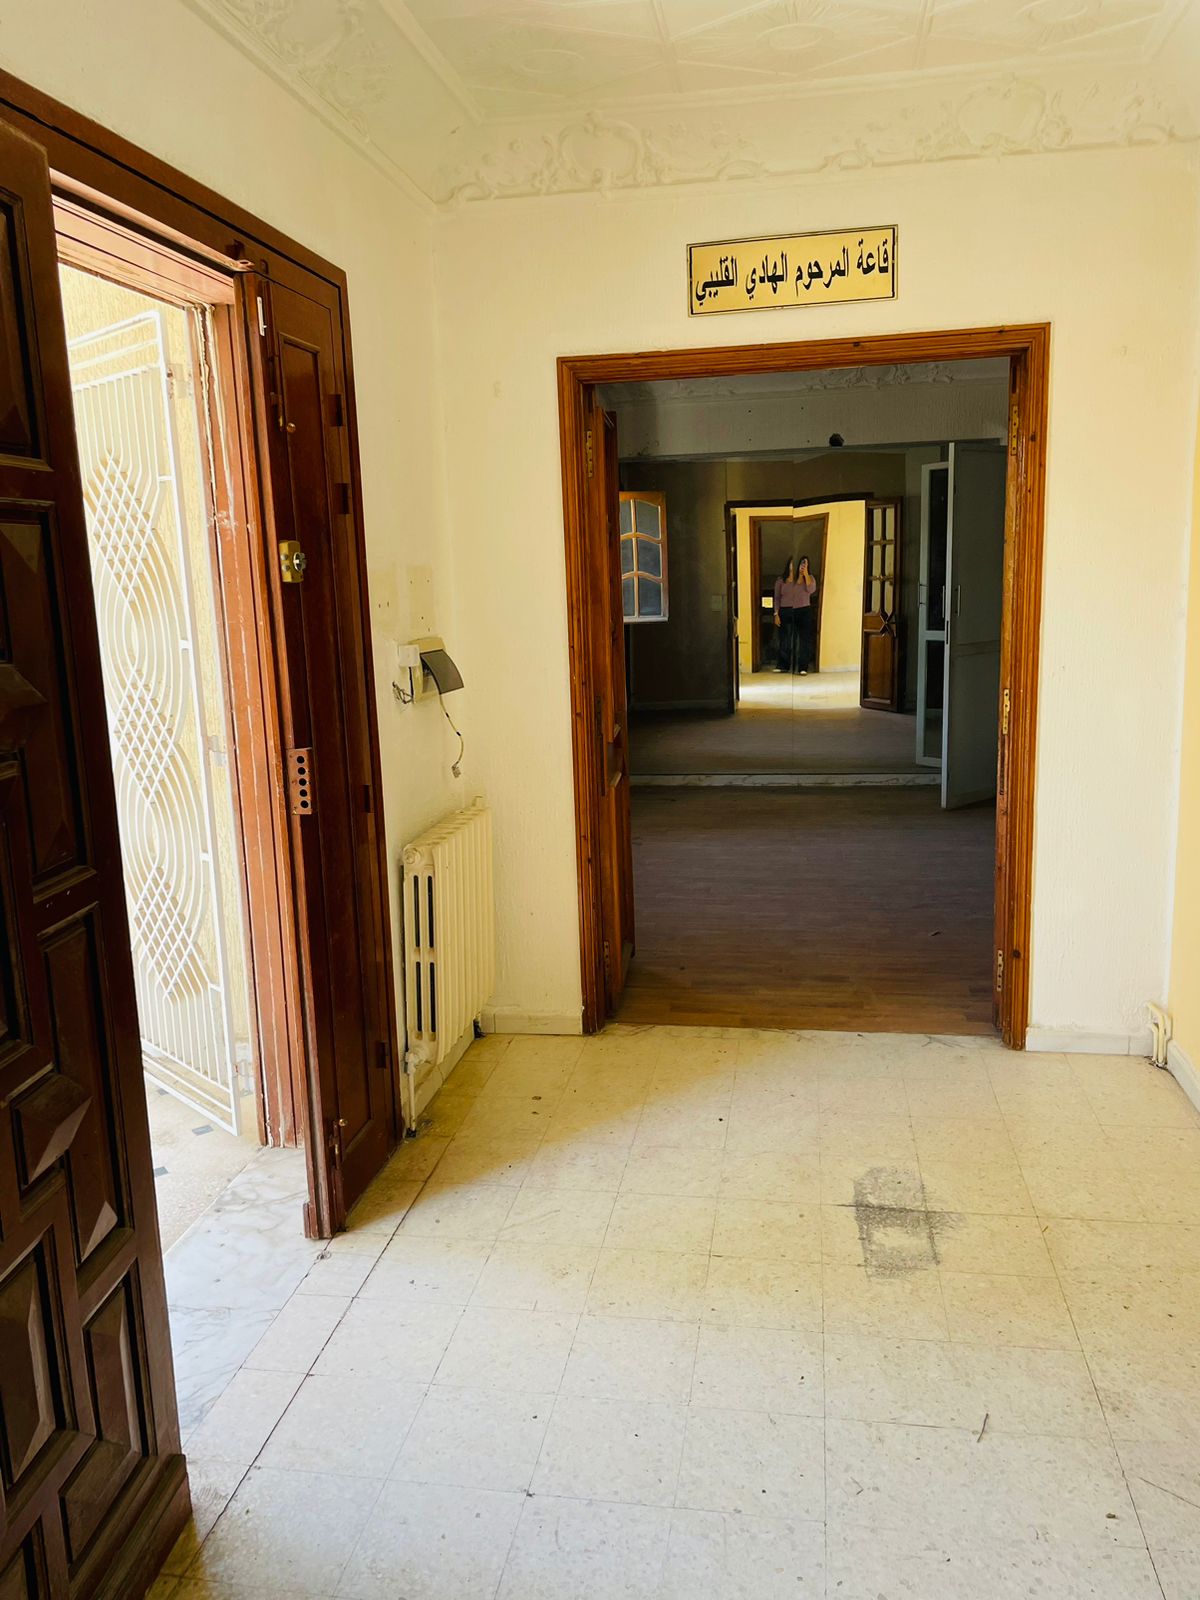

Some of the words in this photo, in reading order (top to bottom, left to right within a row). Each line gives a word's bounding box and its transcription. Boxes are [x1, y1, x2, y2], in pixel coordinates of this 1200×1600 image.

[695, 255, 738, 306] القليبي
[745, 250, 788, 300] الهادي
[795, 245, 849, 297] المرحوم
[856, 238, 889, 275] قاعة
